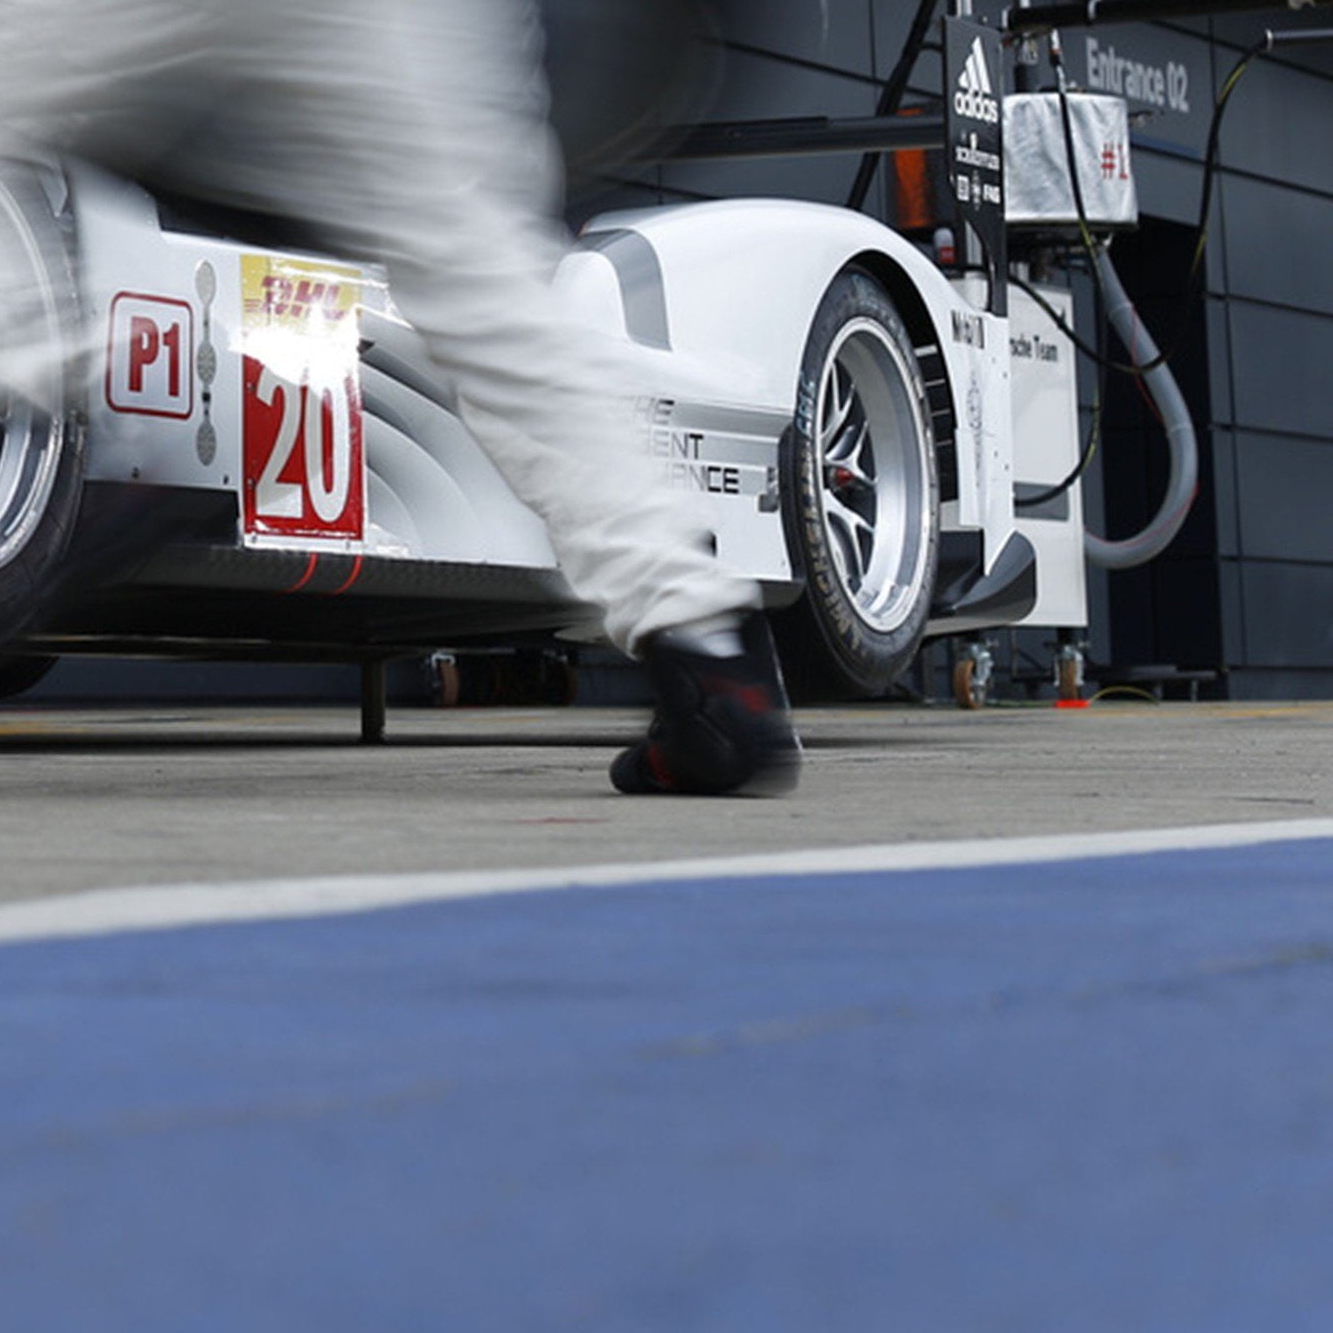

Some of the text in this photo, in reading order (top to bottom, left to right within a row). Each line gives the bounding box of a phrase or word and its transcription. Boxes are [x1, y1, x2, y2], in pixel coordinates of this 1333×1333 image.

[954, 88, 998, 124] adidas
[1086, 37, 1190, 114] Entrance 02
[1101, 143, 1129, 180] #1
[128, 316, 180, 397] P1
[255, 363, 351, 523] 20
